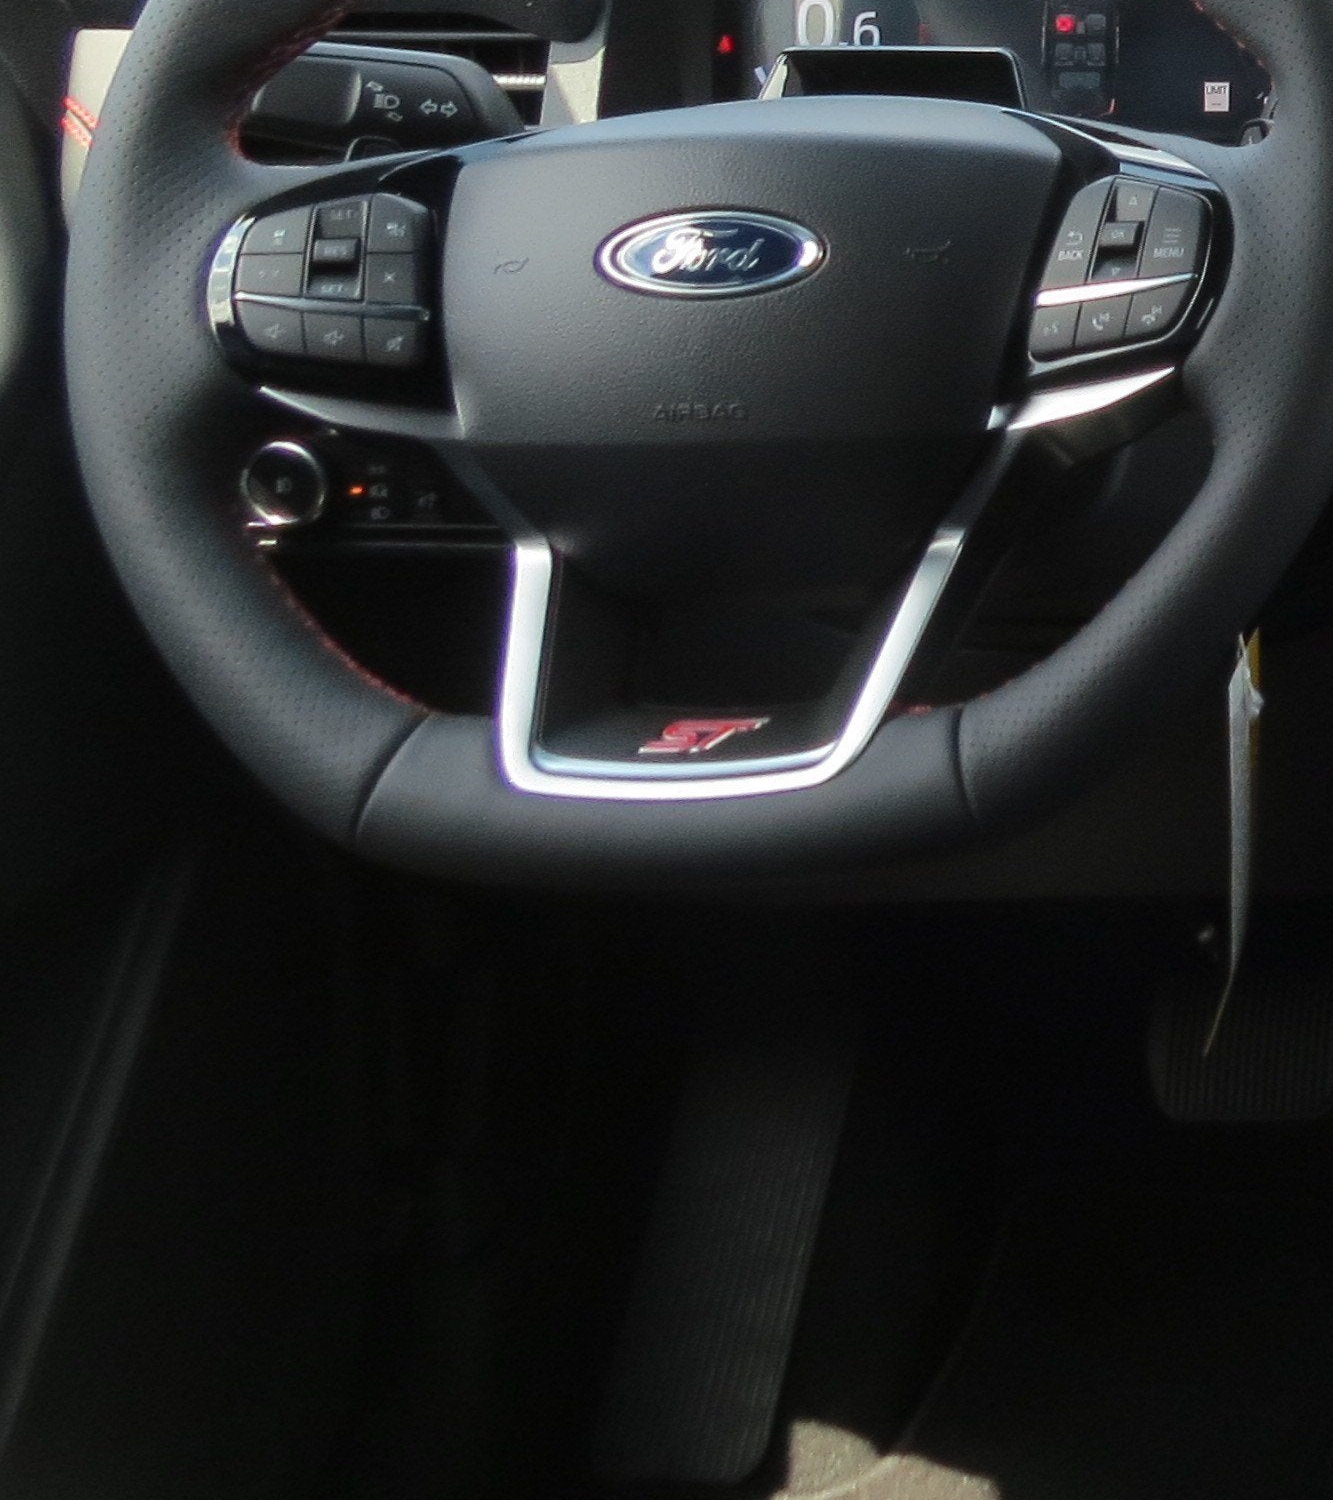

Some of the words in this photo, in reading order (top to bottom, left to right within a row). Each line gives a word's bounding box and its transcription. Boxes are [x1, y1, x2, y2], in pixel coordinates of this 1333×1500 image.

[652, 227, 765, 274] Ford
[1057, 250, 1083, 262] BACK
[1153, 248, 1185, 258] MENU
[638, 716, 772, 754] ST
